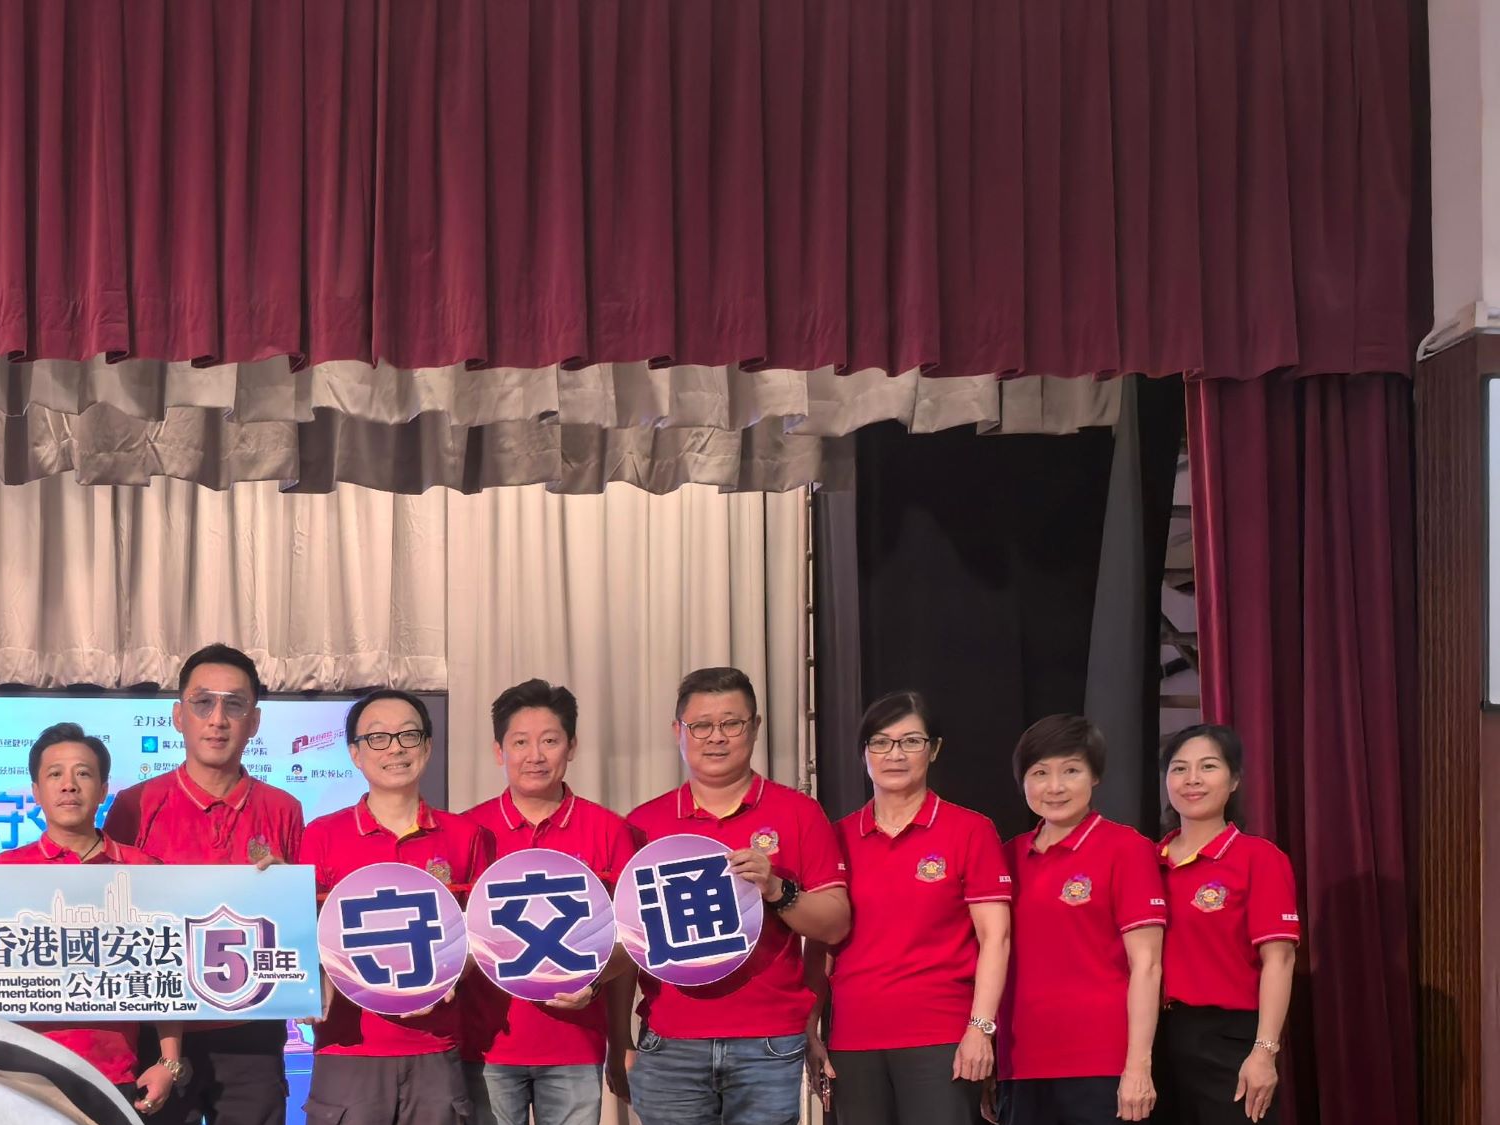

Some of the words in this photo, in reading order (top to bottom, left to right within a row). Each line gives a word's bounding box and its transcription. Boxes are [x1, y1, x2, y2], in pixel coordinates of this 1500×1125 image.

[339, 888, 443, 989] 守
[486, 871, 598, 980] 交
[633, 852, 748, 967] 通
[67, 970, 183, 999] 公布實施
[203, 930, 247, 994] 5
[253, 950, 297, 971] 周年
[30, 1001, 62, 1014] Kong
[65, 1001, 116, 1012] National
[119, 1001, 169, 1014] Security
[172, 1001, 197, 1012] Law
